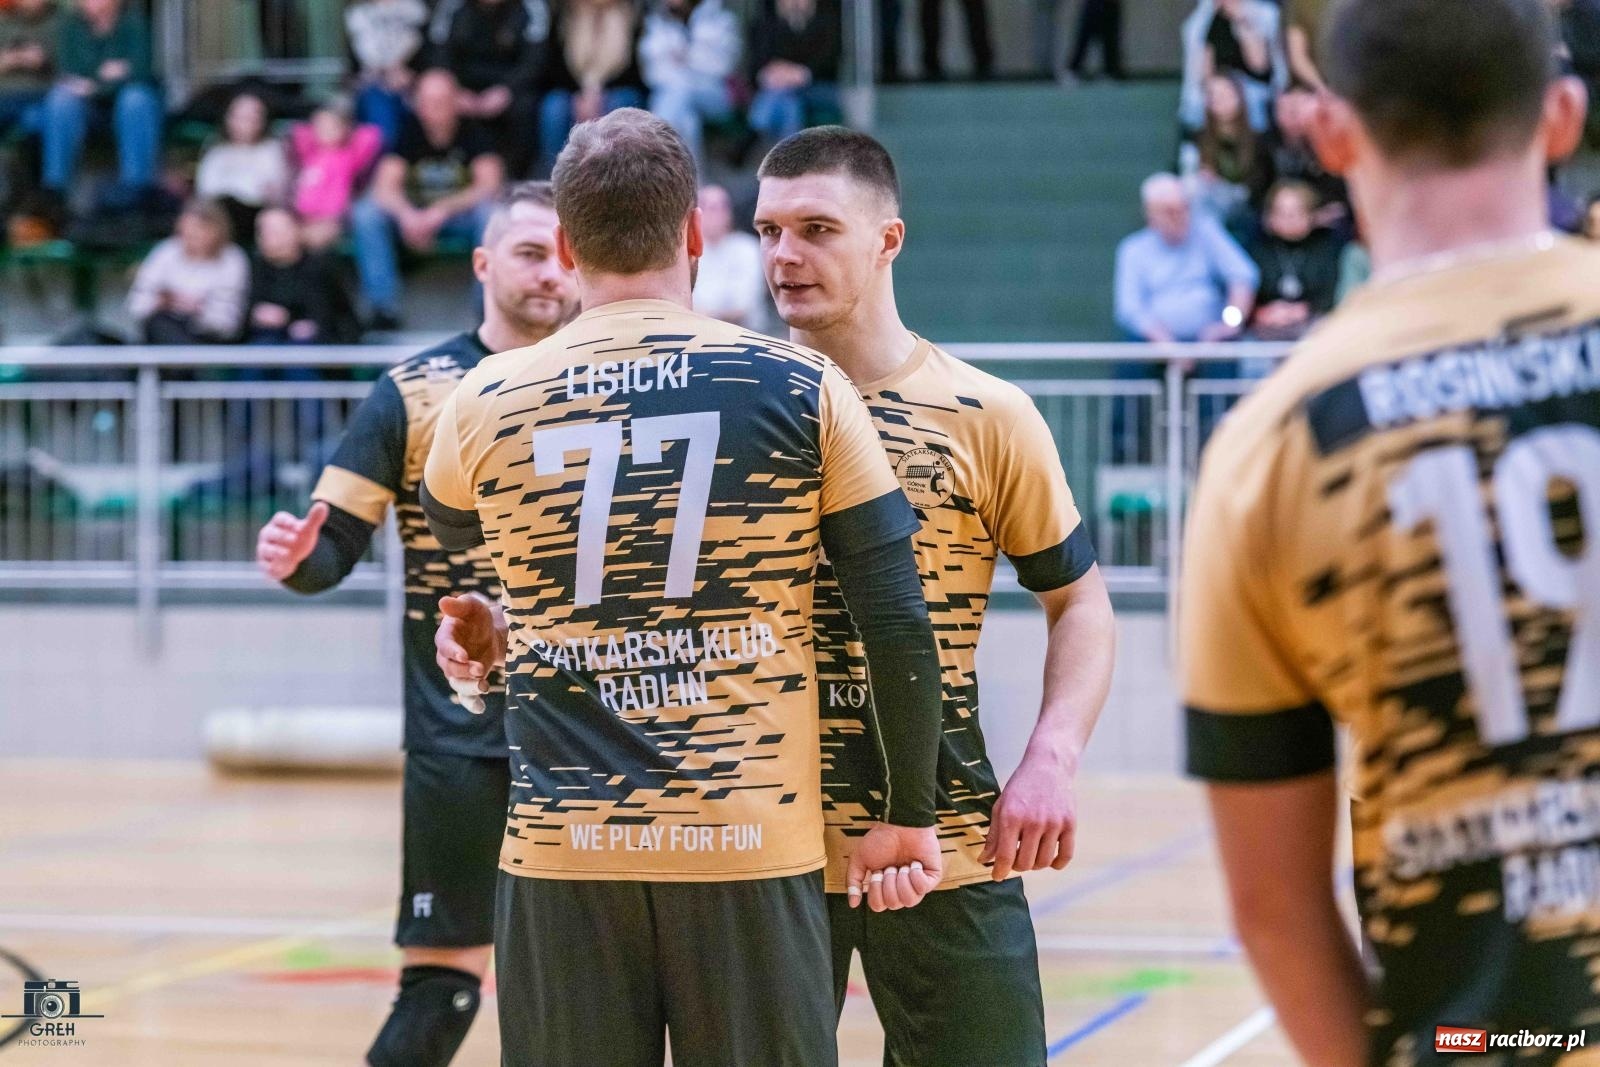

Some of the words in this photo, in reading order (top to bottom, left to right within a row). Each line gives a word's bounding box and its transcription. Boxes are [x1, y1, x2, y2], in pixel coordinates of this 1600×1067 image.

[566, 354, 689, 400] LISICKI
[532, 411, 721, 606] 77
[1388, 424, 1600, 745] 19
[700, 623, 777, 660] KLUB
[599, 671, 708, 712] RADLIN
[570, 823, 604, 850] WE
[610, 824, 664, 852] PLAY
[670, 825, 714, 852] FOR
[721, 823, 763, 851] FUN
